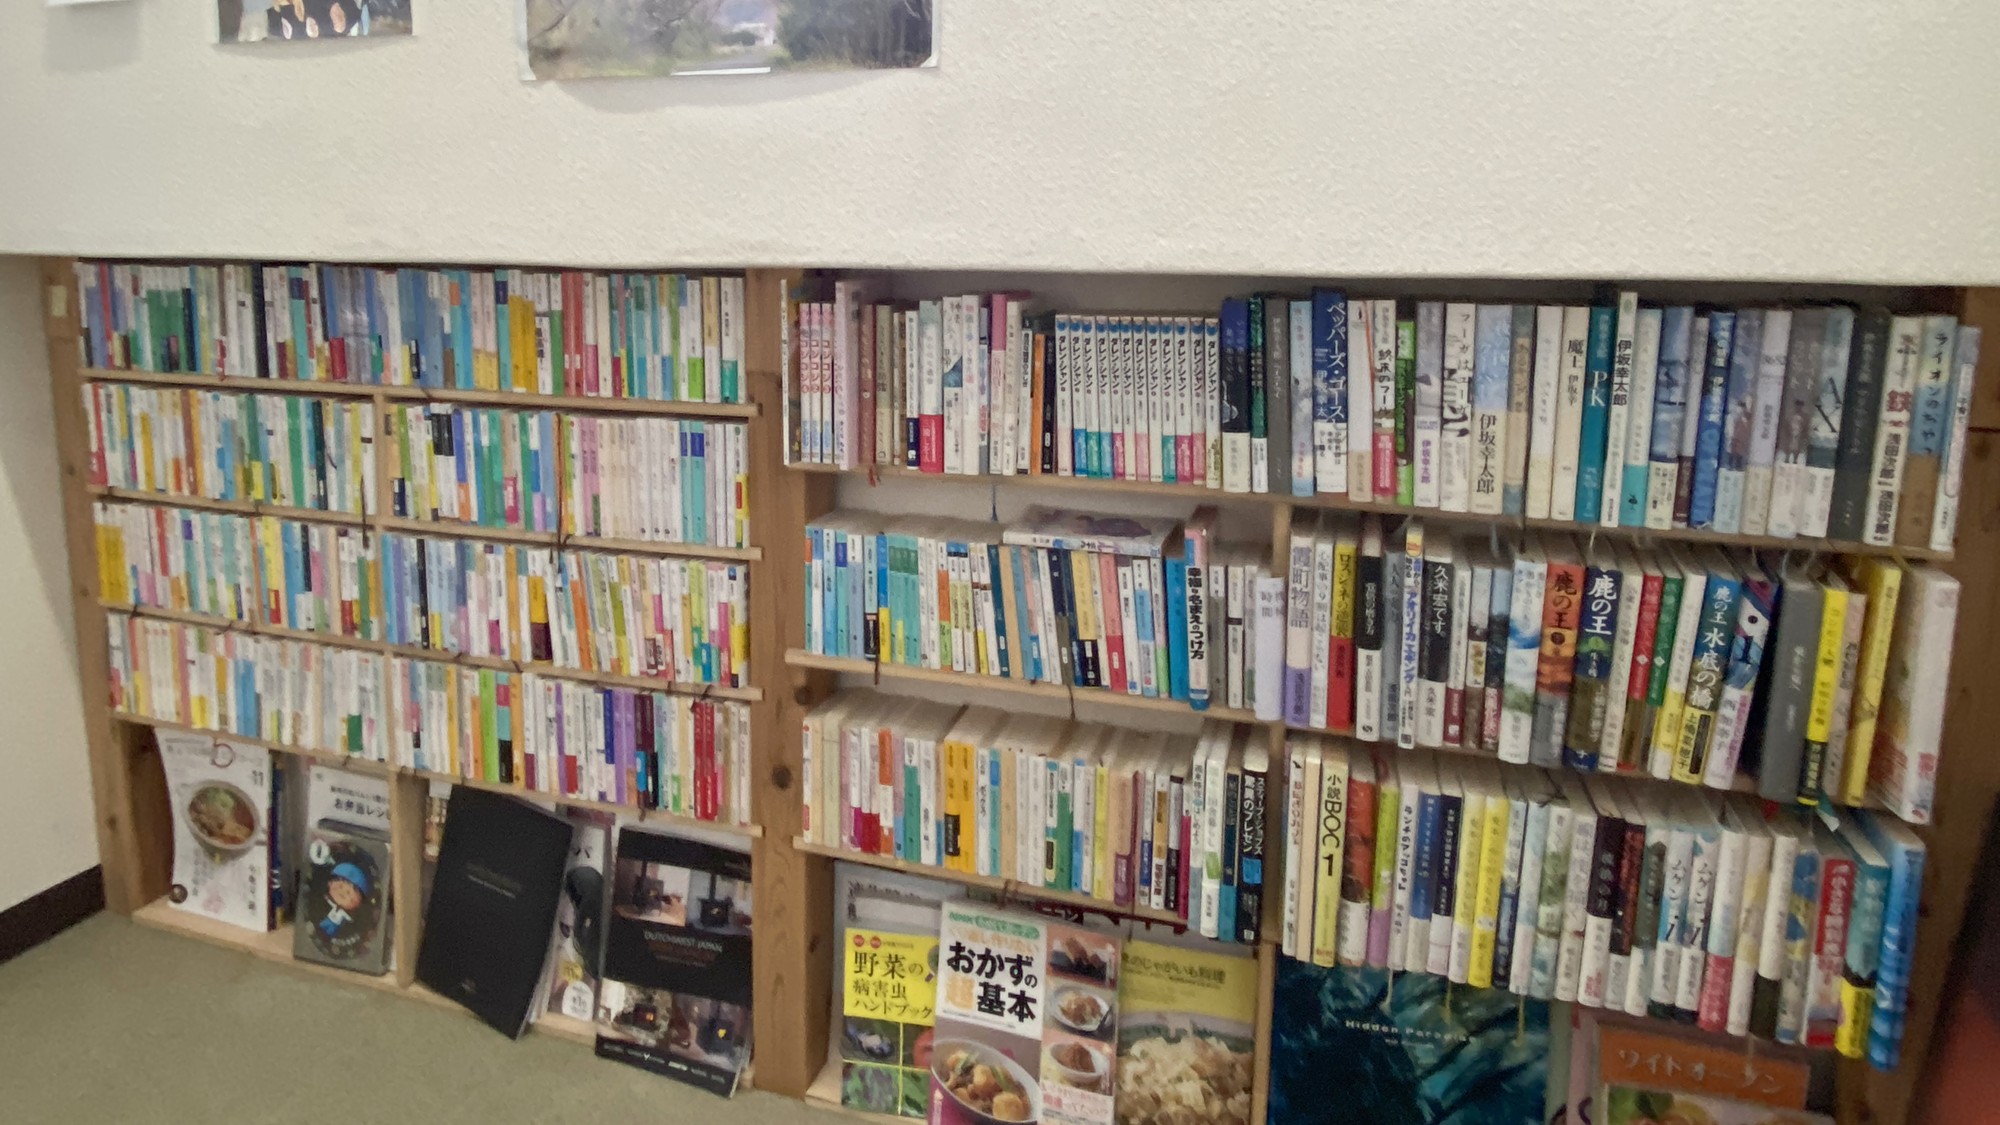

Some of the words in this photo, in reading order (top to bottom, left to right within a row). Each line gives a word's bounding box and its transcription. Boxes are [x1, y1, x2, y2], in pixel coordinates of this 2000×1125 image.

[1611, 339, 1633, 406] 伊坂幸太郎
[1475, 413, 1497, 495] 伊坂幸太郎
[1291, 546, 1312, 628] 霞町物語
[1431, 564, 1449, 638] 久米宏です。
[1551, 572, 1577, 629] 鹿の王
[1584, 574, 1618, 637] 鹿の王
[1708, 584, 1732, 626] 鹿の王
[1690, 627, 1728, 711] 水底の橋
[1322, 853, 1334, 877] 1
[853, 951, 924, 980] 野菜の
[946, 940, 1039, 989] おかずの
[853, 978, 908, 1001] 病害虫
[853, 999, 933, 1019] ハンドブック
[976, 981, 1038, 1023] 基本
[1345, 1020, 1399, 1034] Hidden
